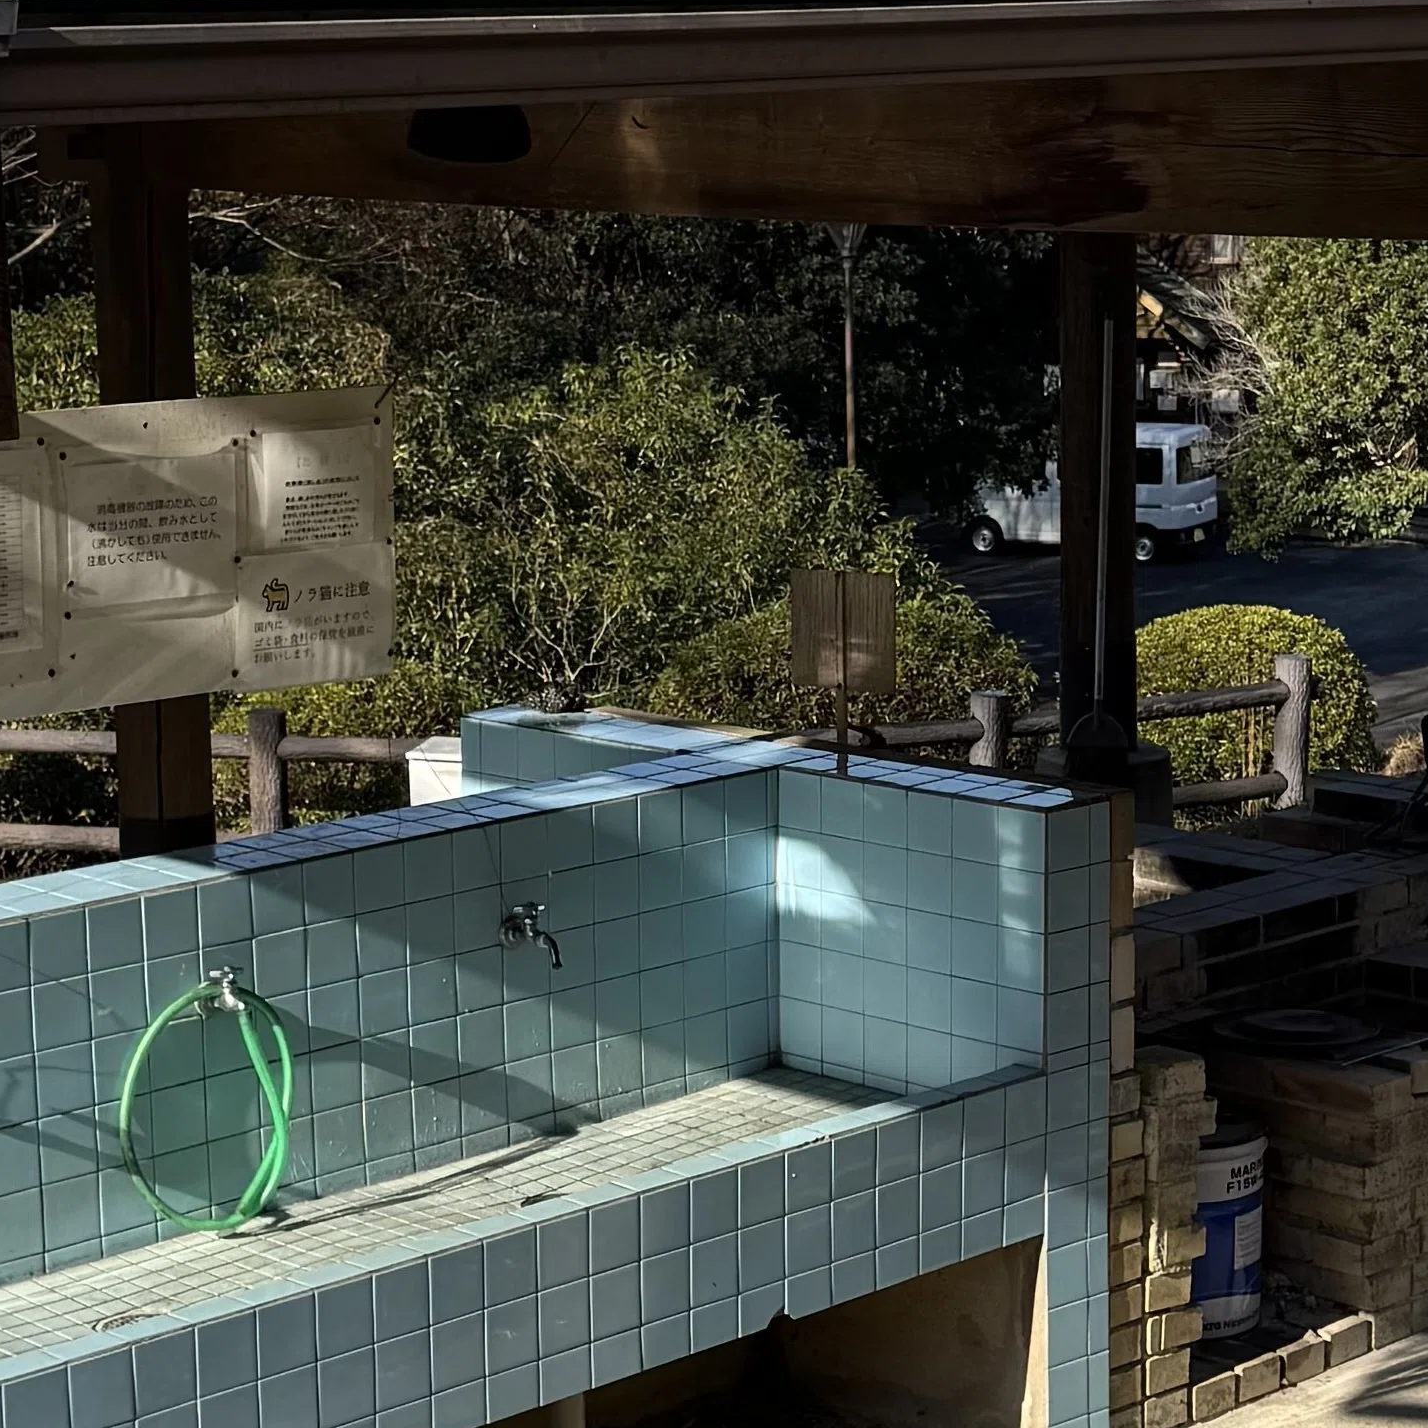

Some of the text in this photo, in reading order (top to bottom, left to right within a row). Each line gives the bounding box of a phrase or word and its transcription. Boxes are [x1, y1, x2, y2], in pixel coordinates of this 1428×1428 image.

[294, 580, 371, 604] ノラ猫に注意
